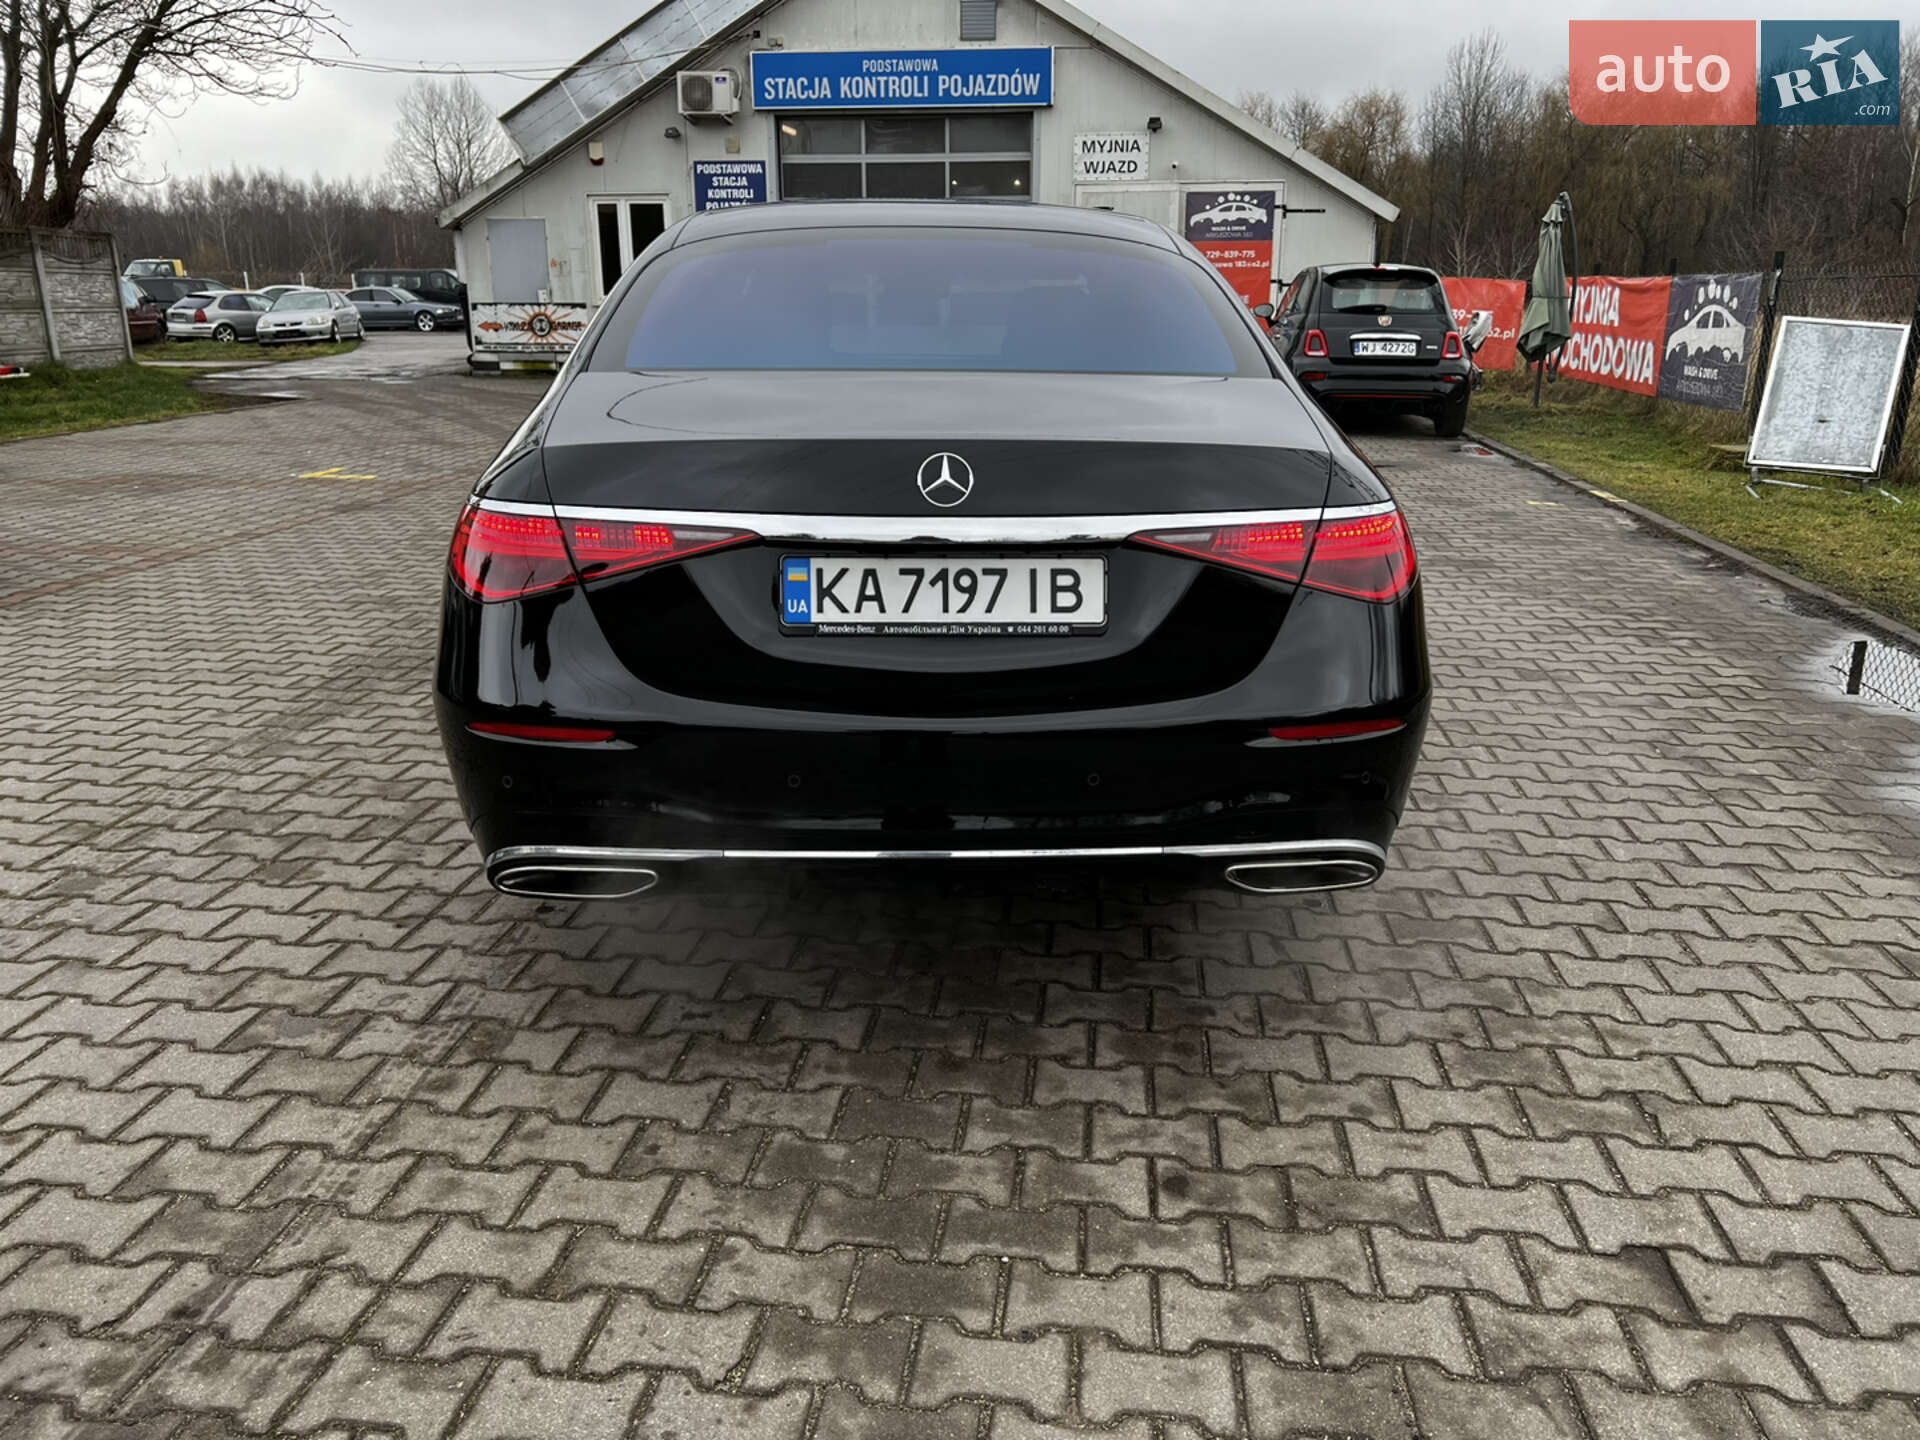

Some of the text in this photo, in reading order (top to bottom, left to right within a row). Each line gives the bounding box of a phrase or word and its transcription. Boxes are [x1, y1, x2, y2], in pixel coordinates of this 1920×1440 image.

[862, 58, 939, 73] PODSTAWOWA
[764, 68, 1041, 100] STACJA KONTROLI POJAZDÓW
[1081, 139, 1141, 154] MYJNIA
[696, 163, 763, 175] PODSTAWOWA
[1083, 160, 1138, 174] WJAZD
[711, 175, 748, 187] STACJA
[707, 188, 754, 199] KONTROLI
[815, 567, 1084, 614] KA 7197 IB
[787, 599, 808, 613] UA
[818, 624, 876, 633] Mercedes-Benz
